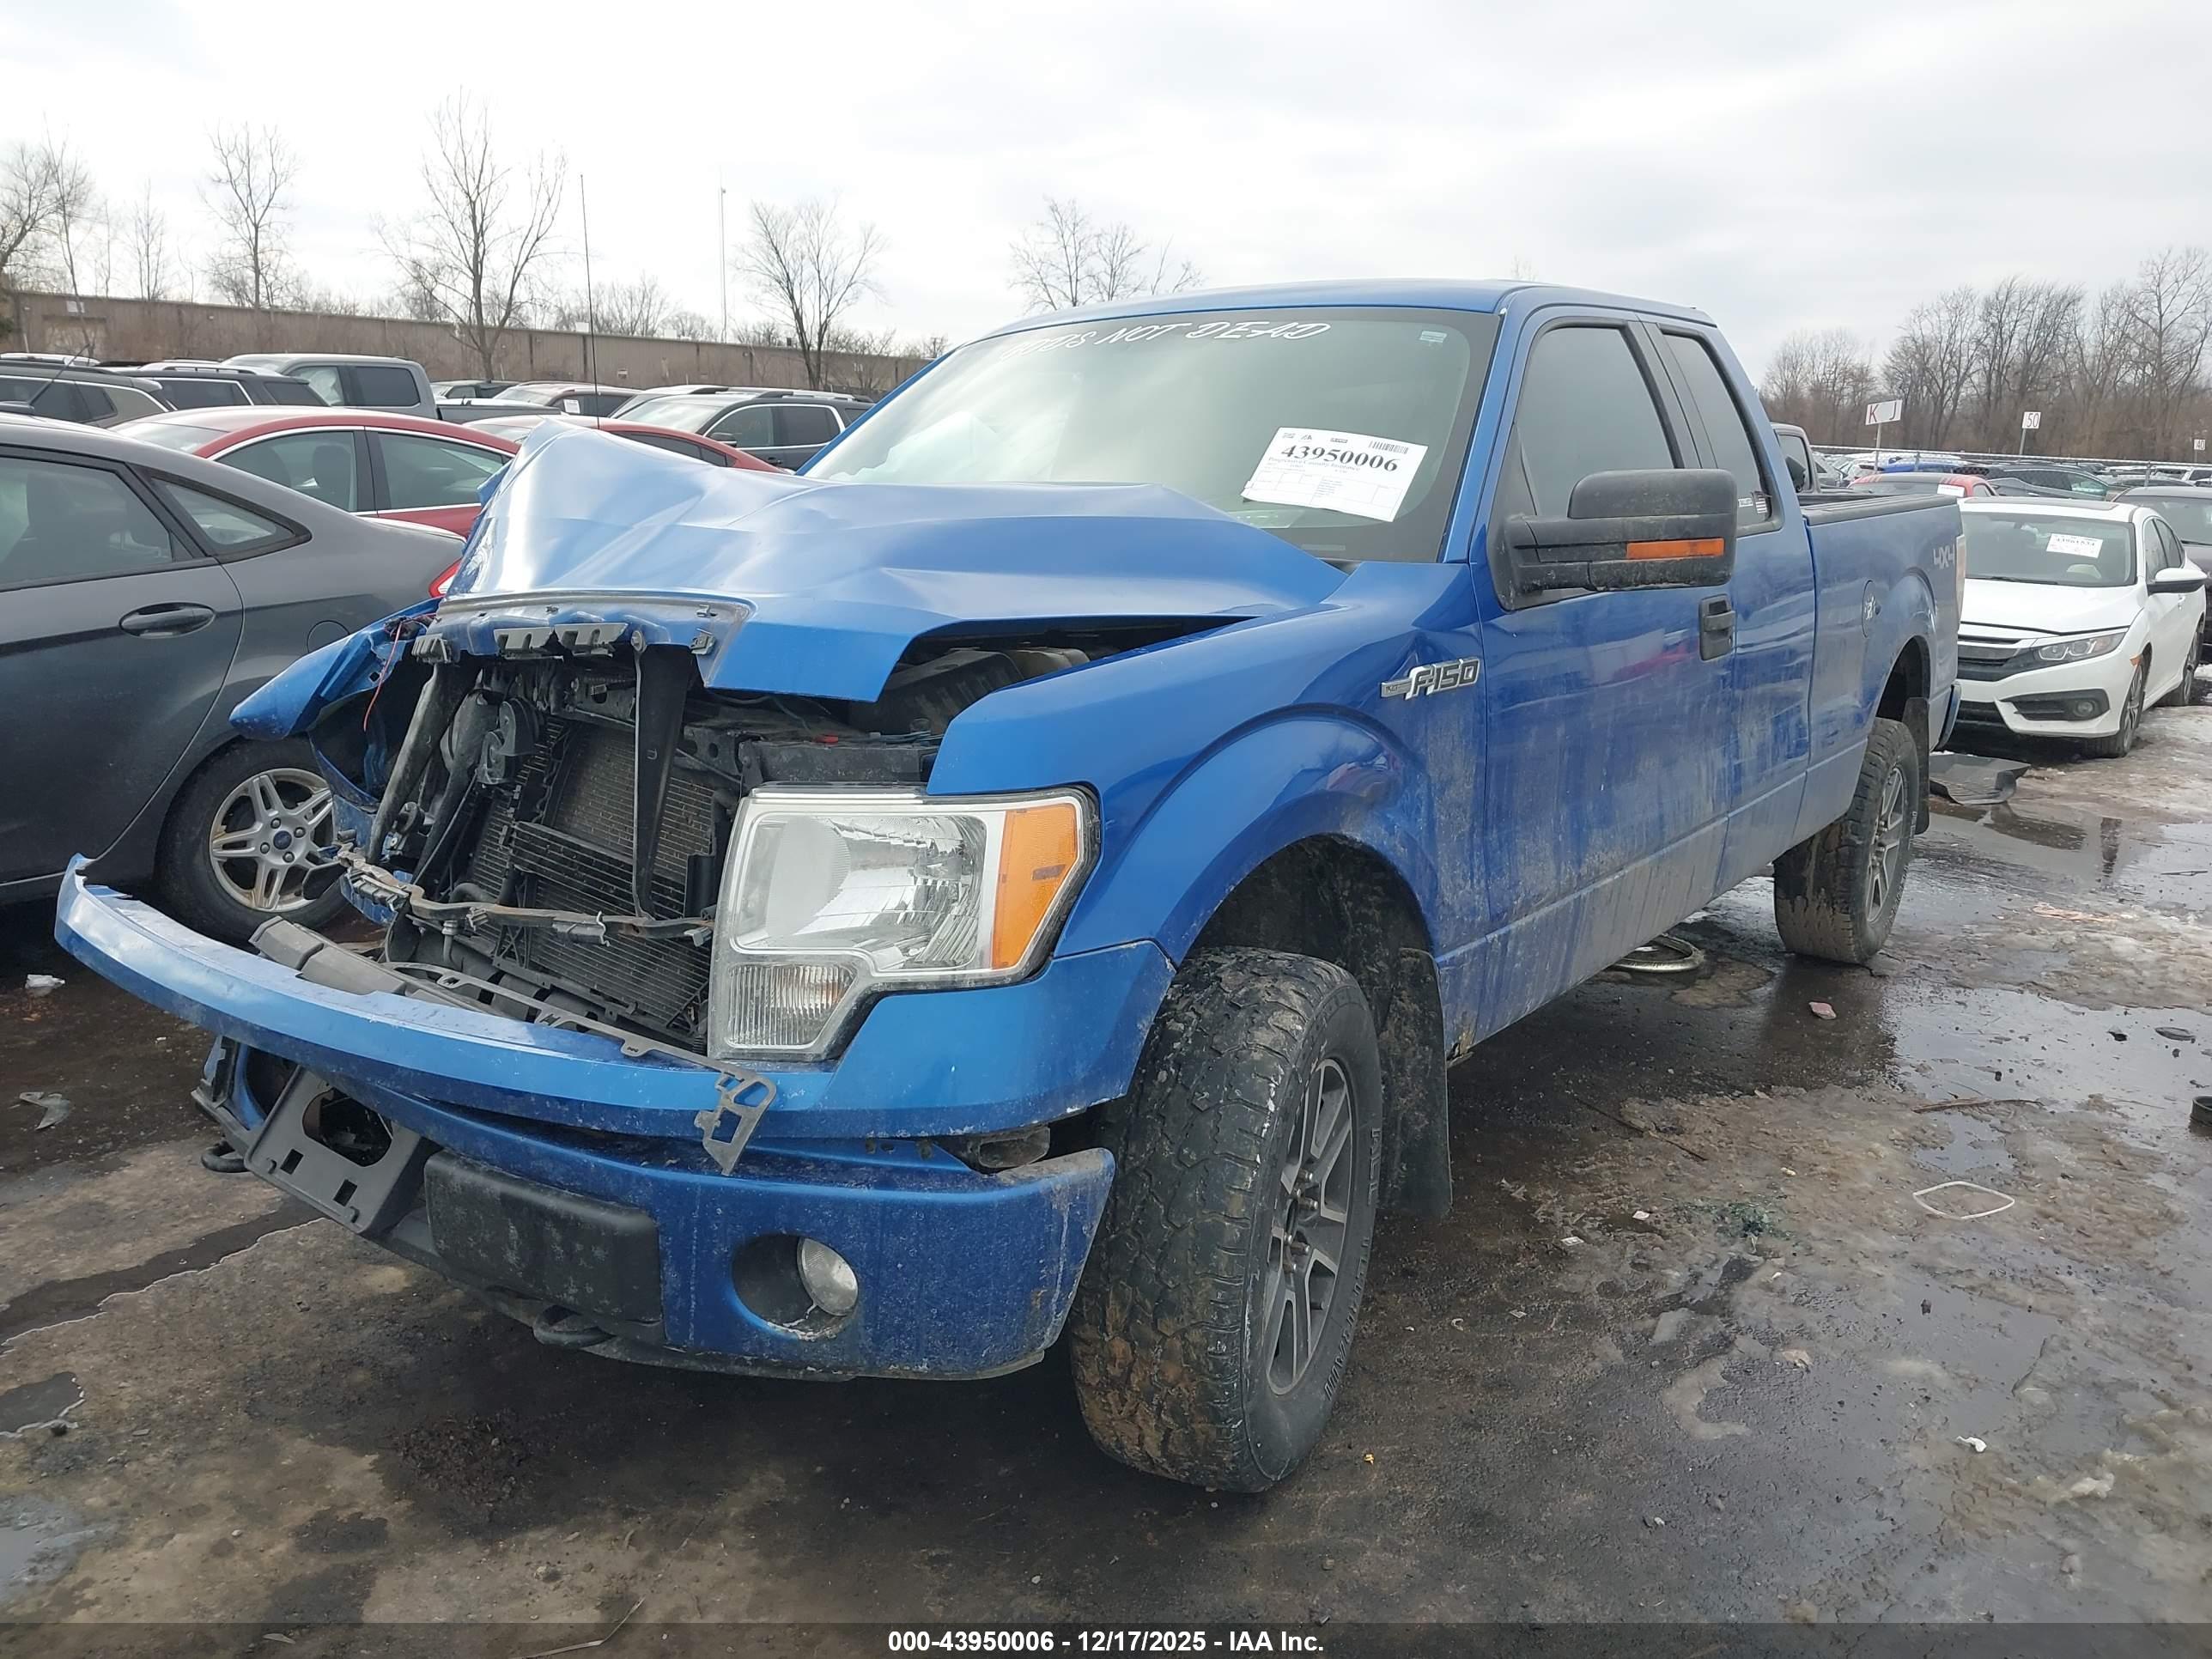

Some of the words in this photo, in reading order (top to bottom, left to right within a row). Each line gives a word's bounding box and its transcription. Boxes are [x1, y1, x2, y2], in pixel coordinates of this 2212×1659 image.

[1093, 322, 1193, 345] NOT
[1185, 320, 1332, 340] DEAD
[1869, 403, 1880, 424] K
[1888, 401, 1897, 421] J
[2026, 411, 2039, 428] 50
[1281, 444, 1401, 472] 43950006
